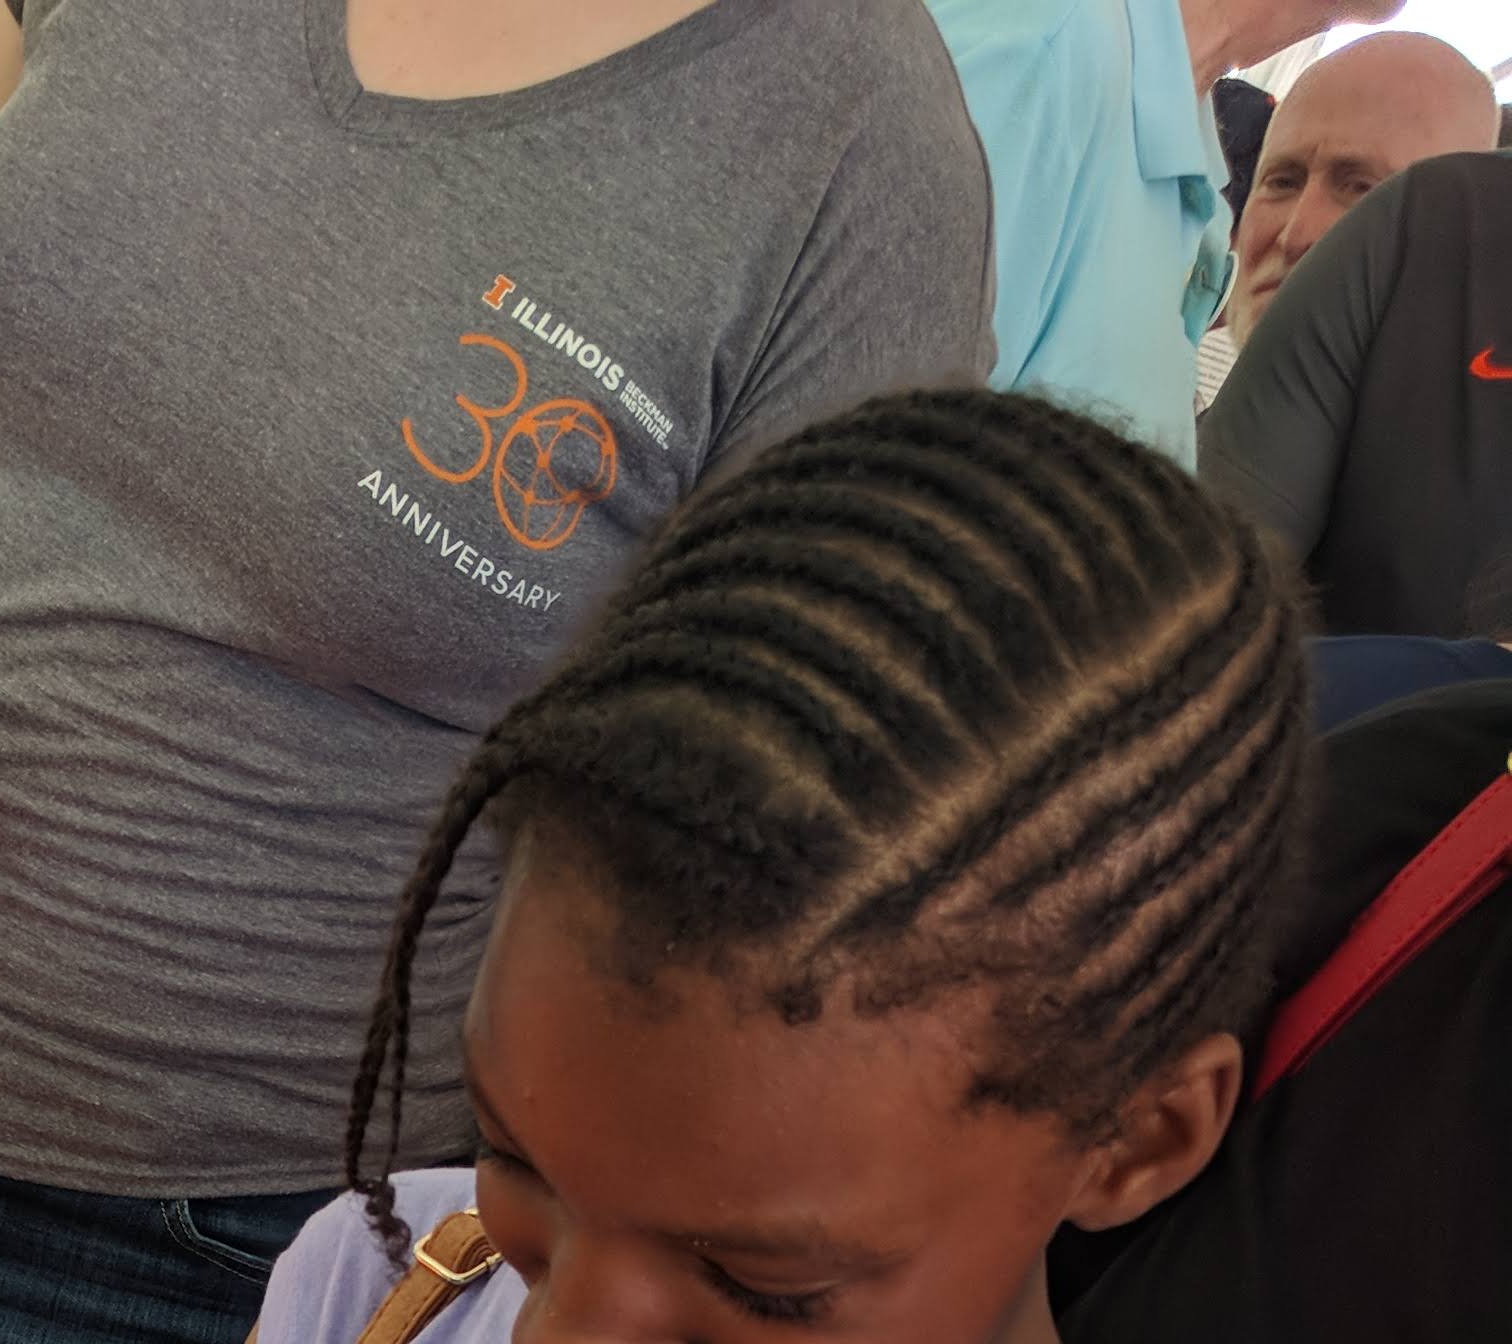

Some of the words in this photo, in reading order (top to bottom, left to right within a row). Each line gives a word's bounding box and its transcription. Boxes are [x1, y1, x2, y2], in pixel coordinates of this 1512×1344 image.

[511, 297, 626, 392] ILLINOIS
[401, 334, 618, 551] 30
[619, 390, 668, 446] INSTITUTE
[624, 379, 674, 434] BECKMAN
[357, 469, 561, 613] ANNIVERSARY
